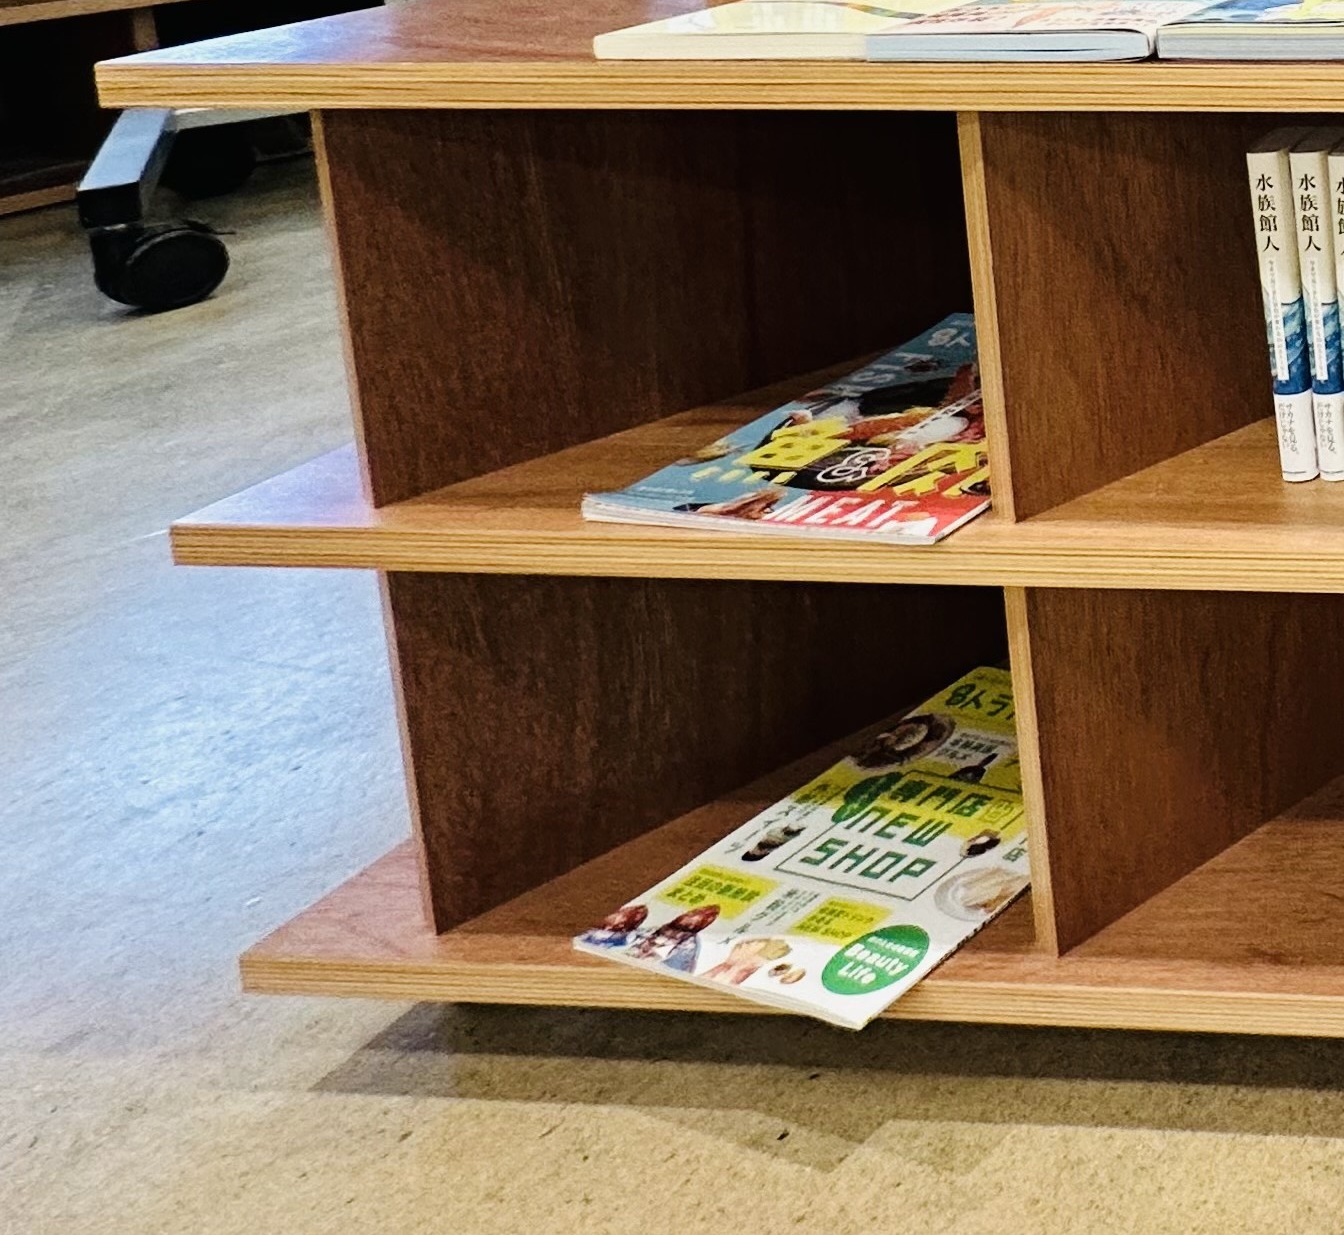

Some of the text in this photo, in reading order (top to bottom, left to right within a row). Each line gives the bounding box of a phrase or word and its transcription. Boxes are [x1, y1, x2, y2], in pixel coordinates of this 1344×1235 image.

[1255, 173, 1280, 253] 水族館人
[1298, 173, 1322, 253] 水族館人
[762, 493, 921, 530] MEAT
[844, 805, 953, 848] NEW
[799, 837, 937, 883] SHOP
[837, 961, 877, 984] Life
[844, 943, 909, 975] Beauty
